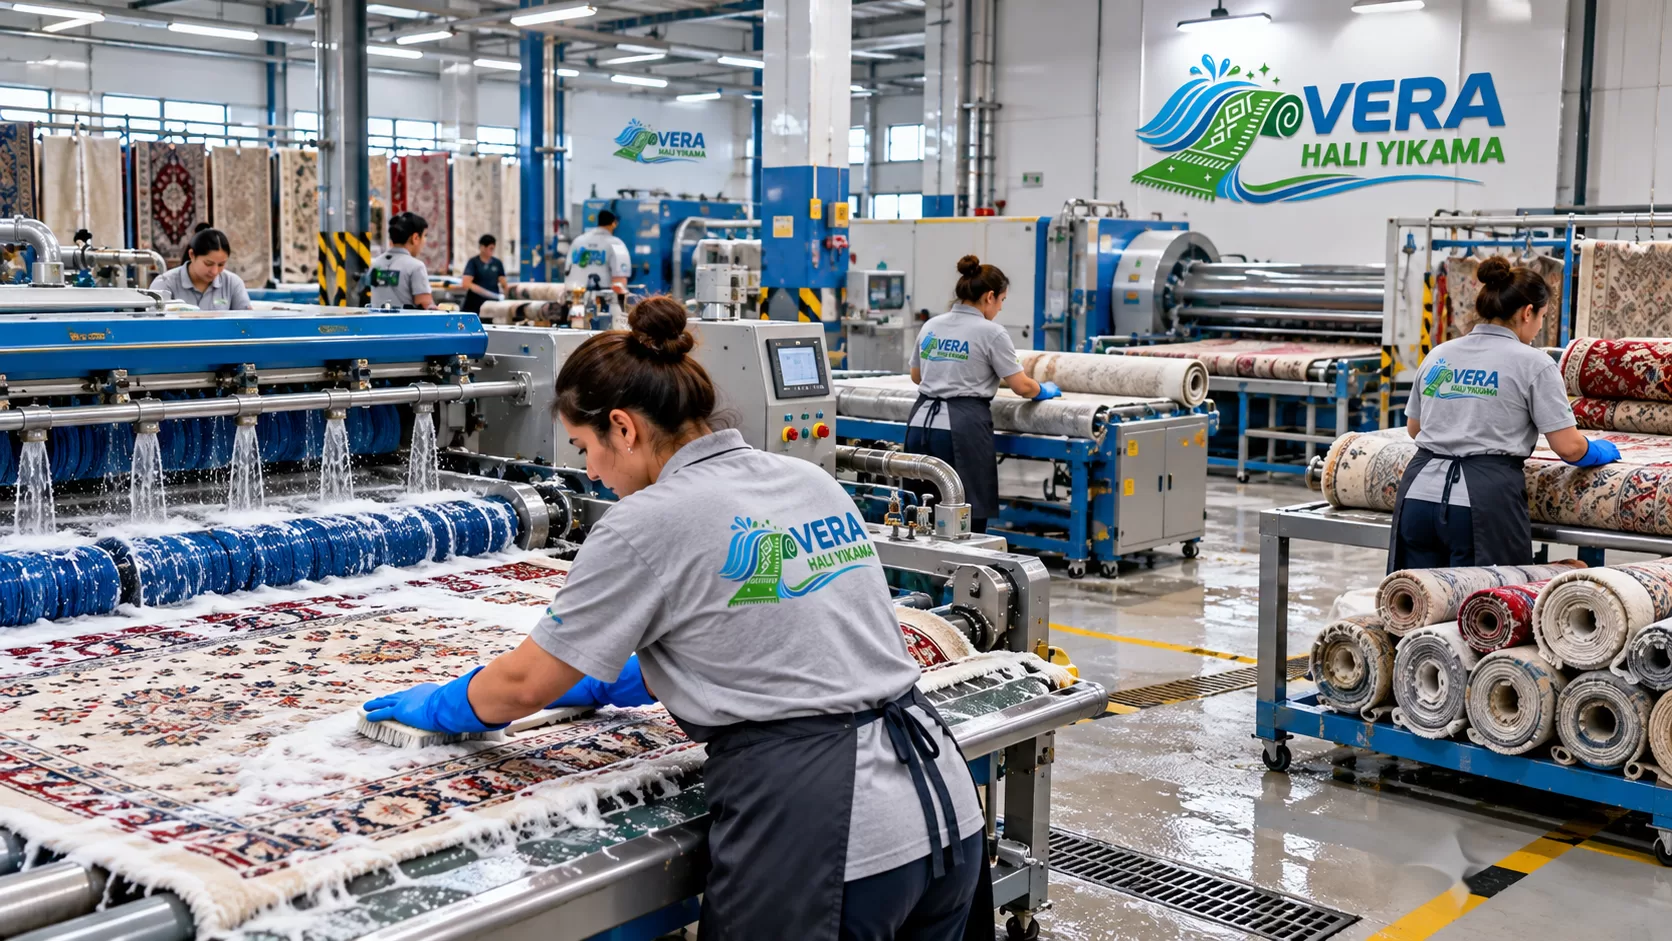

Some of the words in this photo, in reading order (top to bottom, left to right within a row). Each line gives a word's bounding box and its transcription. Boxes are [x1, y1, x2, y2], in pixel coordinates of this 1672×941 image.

[1303, 72, 1506, 135] VERA
[657, 131, 706, 149] VERA
[1301, 141, 1368, 168] HALI
[1376, 136, 1506, 166] YIKAMA
[938, 338, 970, 354] VERA
[1453, 368, 1499, 389] VERA
[788, 511, 868, 554] VERA
[807, 552, 836, 572] HALI
